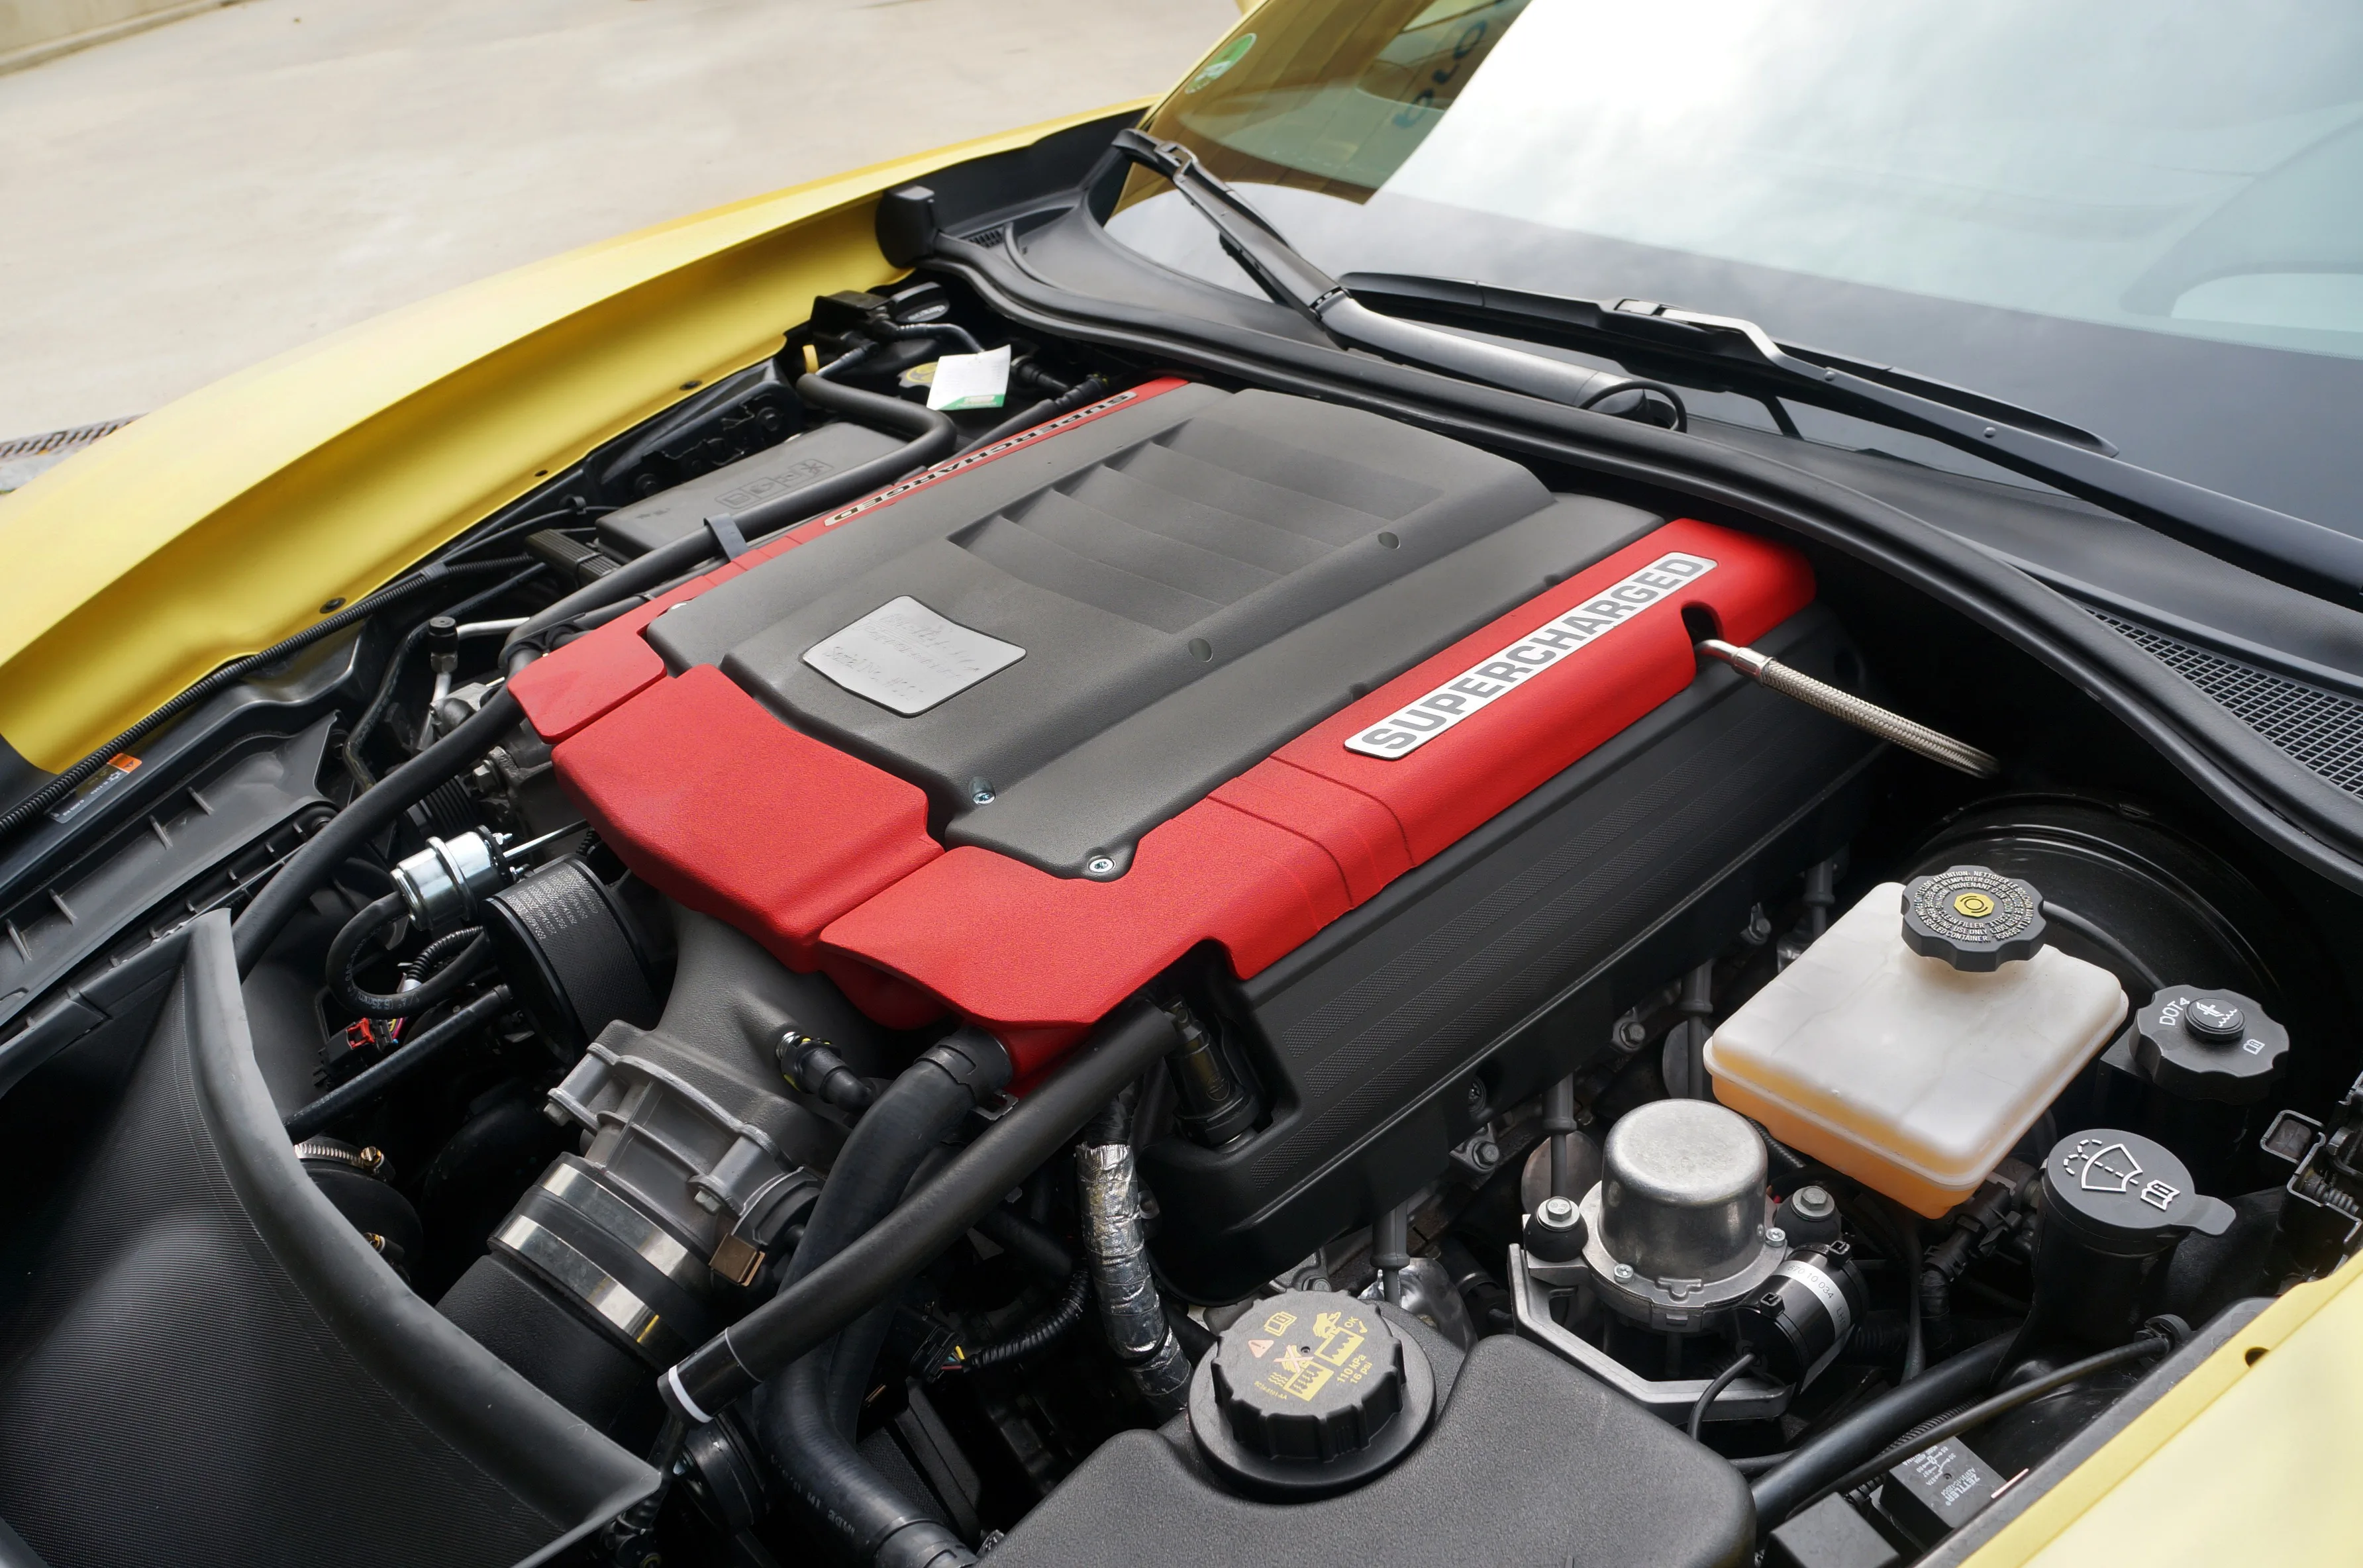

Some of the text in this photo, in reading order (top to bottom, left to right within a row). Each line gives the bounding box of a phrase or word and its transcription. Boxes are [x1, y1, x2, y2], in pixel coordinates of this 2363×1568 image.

[834, 394, 1129, 521] SUPERCHARGED
[1362, 557, 1706, 751] SUPERCHARGED
[1949, 882, 1991, 891] PROVENANT
[1974, 871, 2009, 885] NETTOYER
[1984, 879, 2000, 887] QUE
[2005, 891, 2023, 907] LIQUIDE
[2014, 887, 2033, 909] BOUCHON
[1923, 918, 1947, 935] SEALED
[1938, 910, 1959, 925] CLEAN
[1958, 920, 1985, 929] FILLER
[2022, 908, 2034, 924] AVANT
[1807, 1273, 1819, 1282] 10
[1819, 1282, 1834, 1299] 034
[1344, 1316, 1358, 1328] OK
[1336, 1353, 1367, 1383] 110 kPa
[1350, 1361, 1373, 1384] 16 psi
